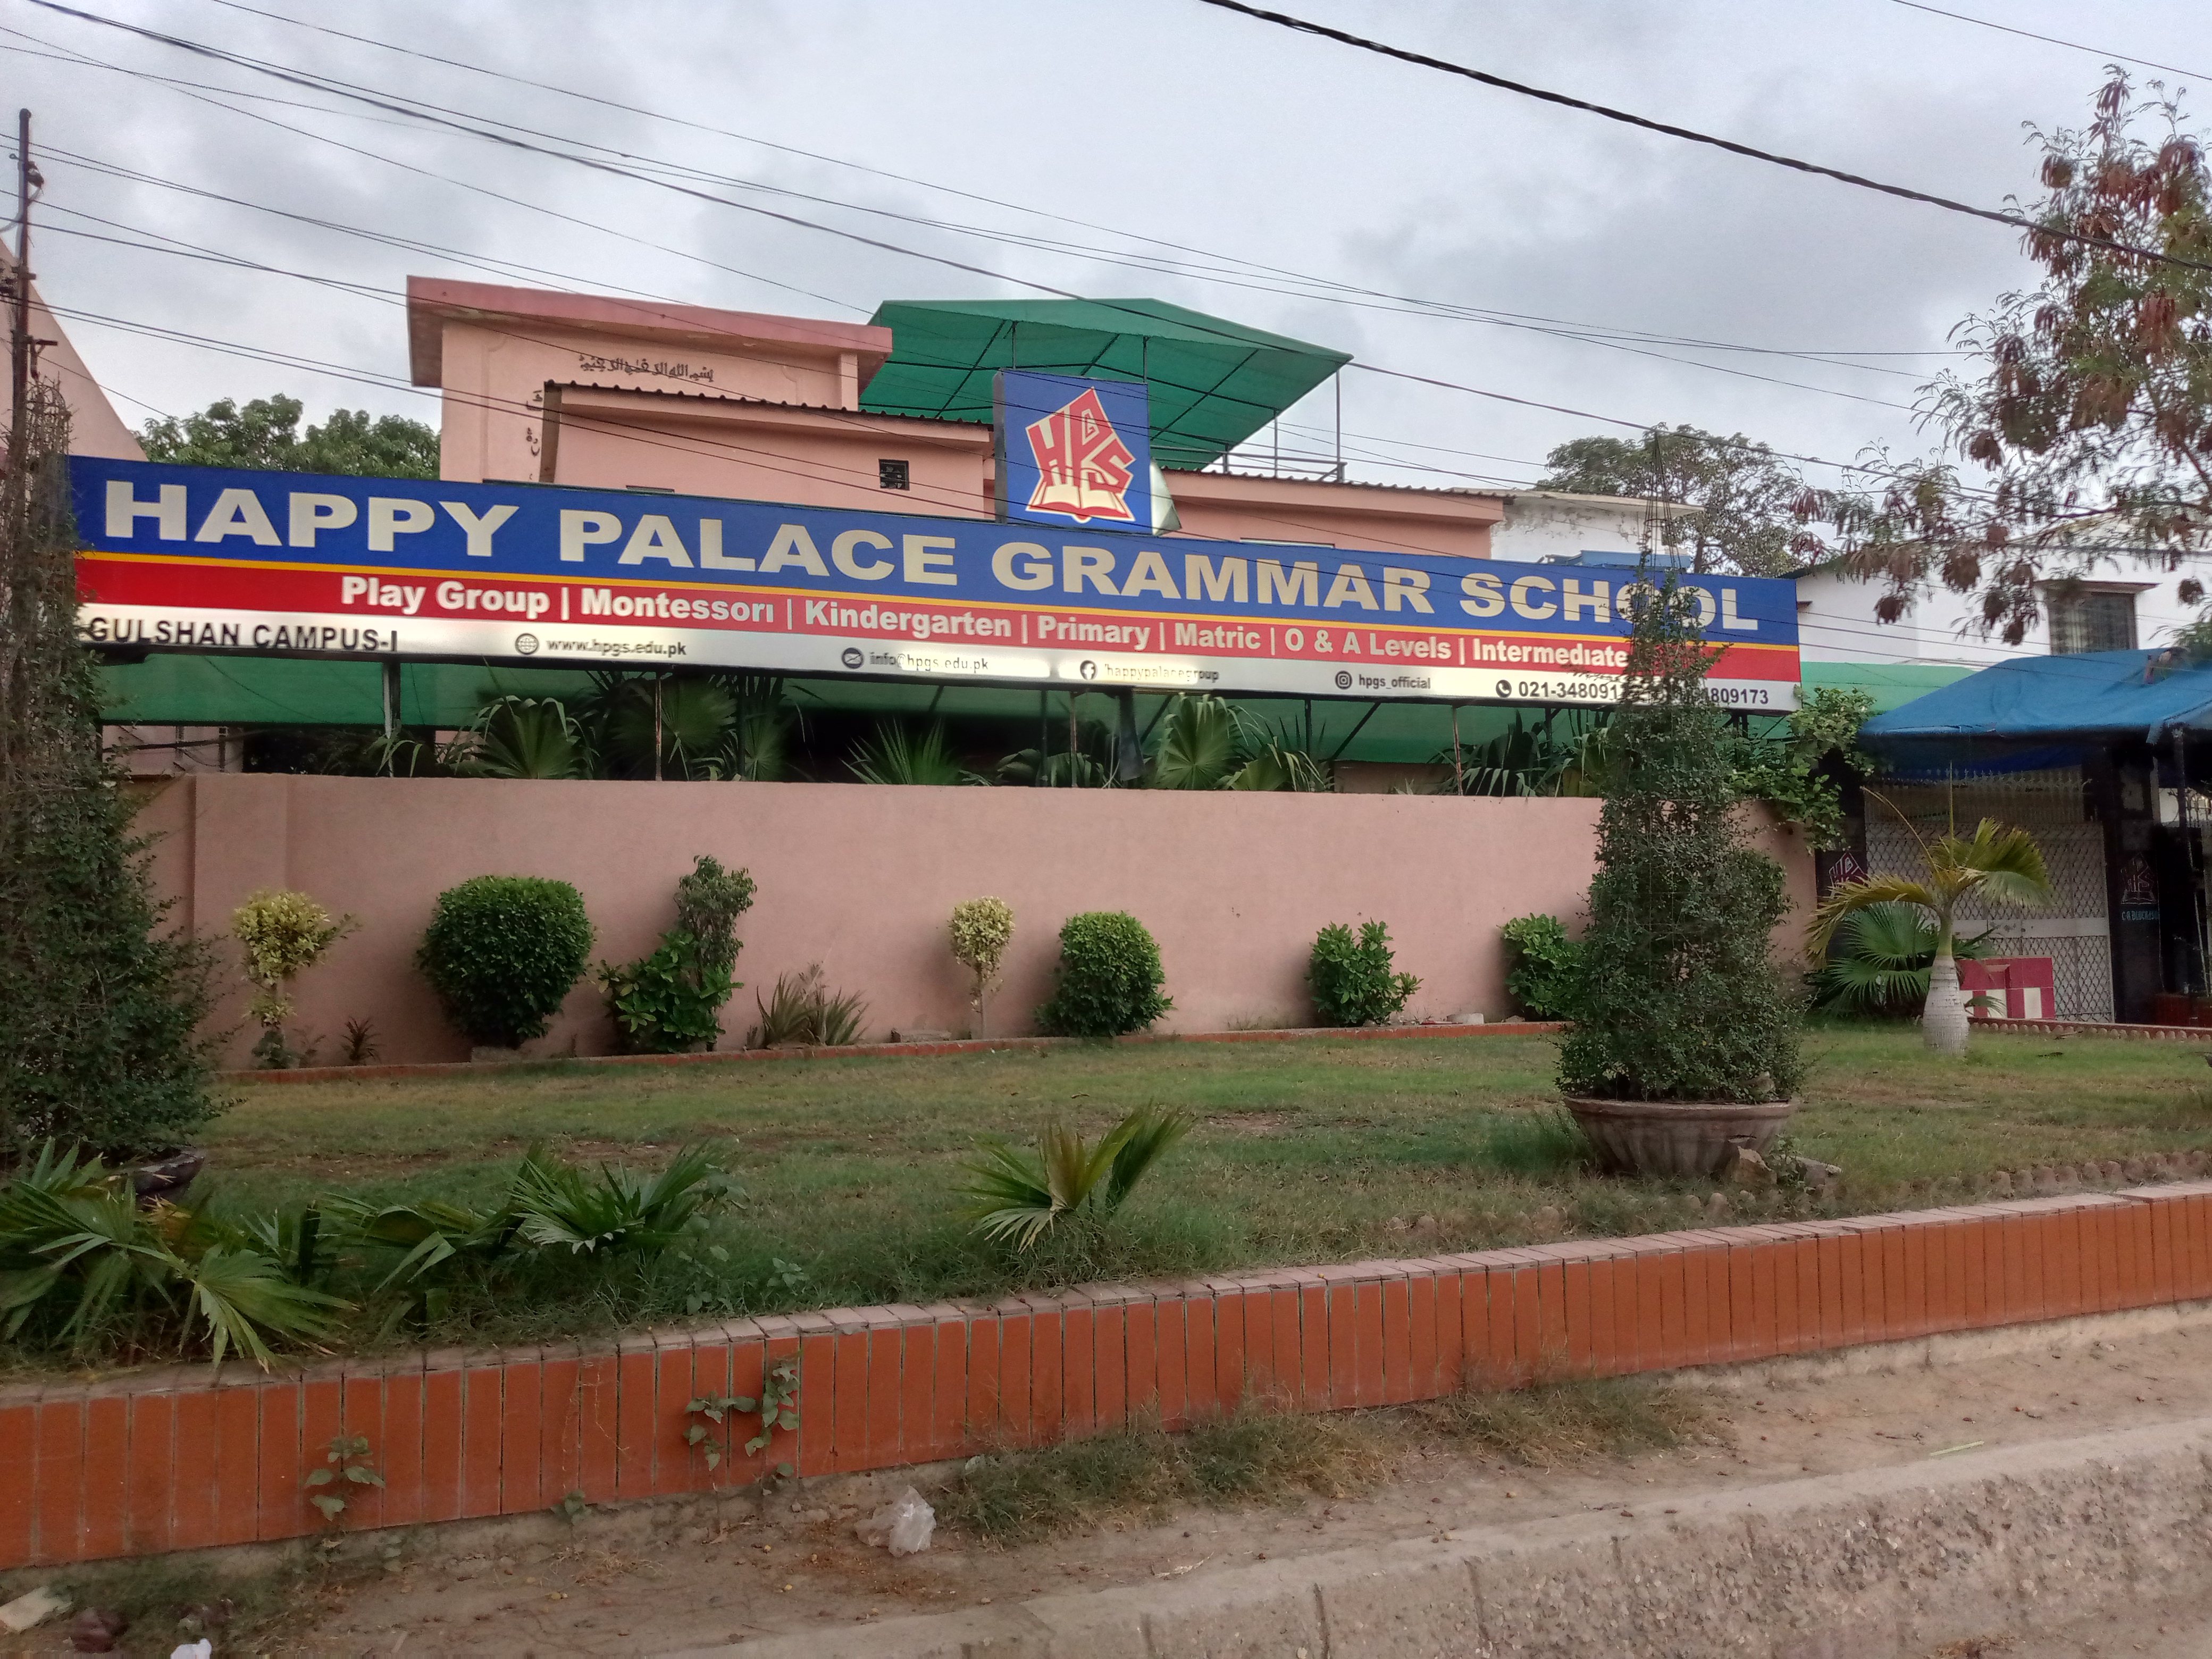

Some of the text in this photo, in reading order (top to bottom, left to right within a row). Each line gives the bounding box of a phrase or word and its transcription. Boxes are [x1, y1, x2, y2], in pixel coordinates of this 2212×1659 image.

[105, 480, 1758, 631] HAPPY PALACE GRAMMAR SCHOOL
[341, 576, 426, 615] Play
[435, 581, 550, 619] Group
[805, 600, 1011, 639] Kindergarten
[1037, 615, 1150, 651] Primary
[1175, 622, 1261, 649] Matric
[1285, 628, 1304, 652] O
[1314, 630, 1333, 653] &
[1341, 632, 1361, 655] A
[1369, 632, 1452, 660] Levels
[90, 617, 397, 652] GULSHAN CAMPUS-I
[546, 639, 686, 658] www.hpgs.edu.pk
[869, 651, 988, 674] info@hpgs.edu.pk
[1359, 674, 1431, 690] hpgs_official
